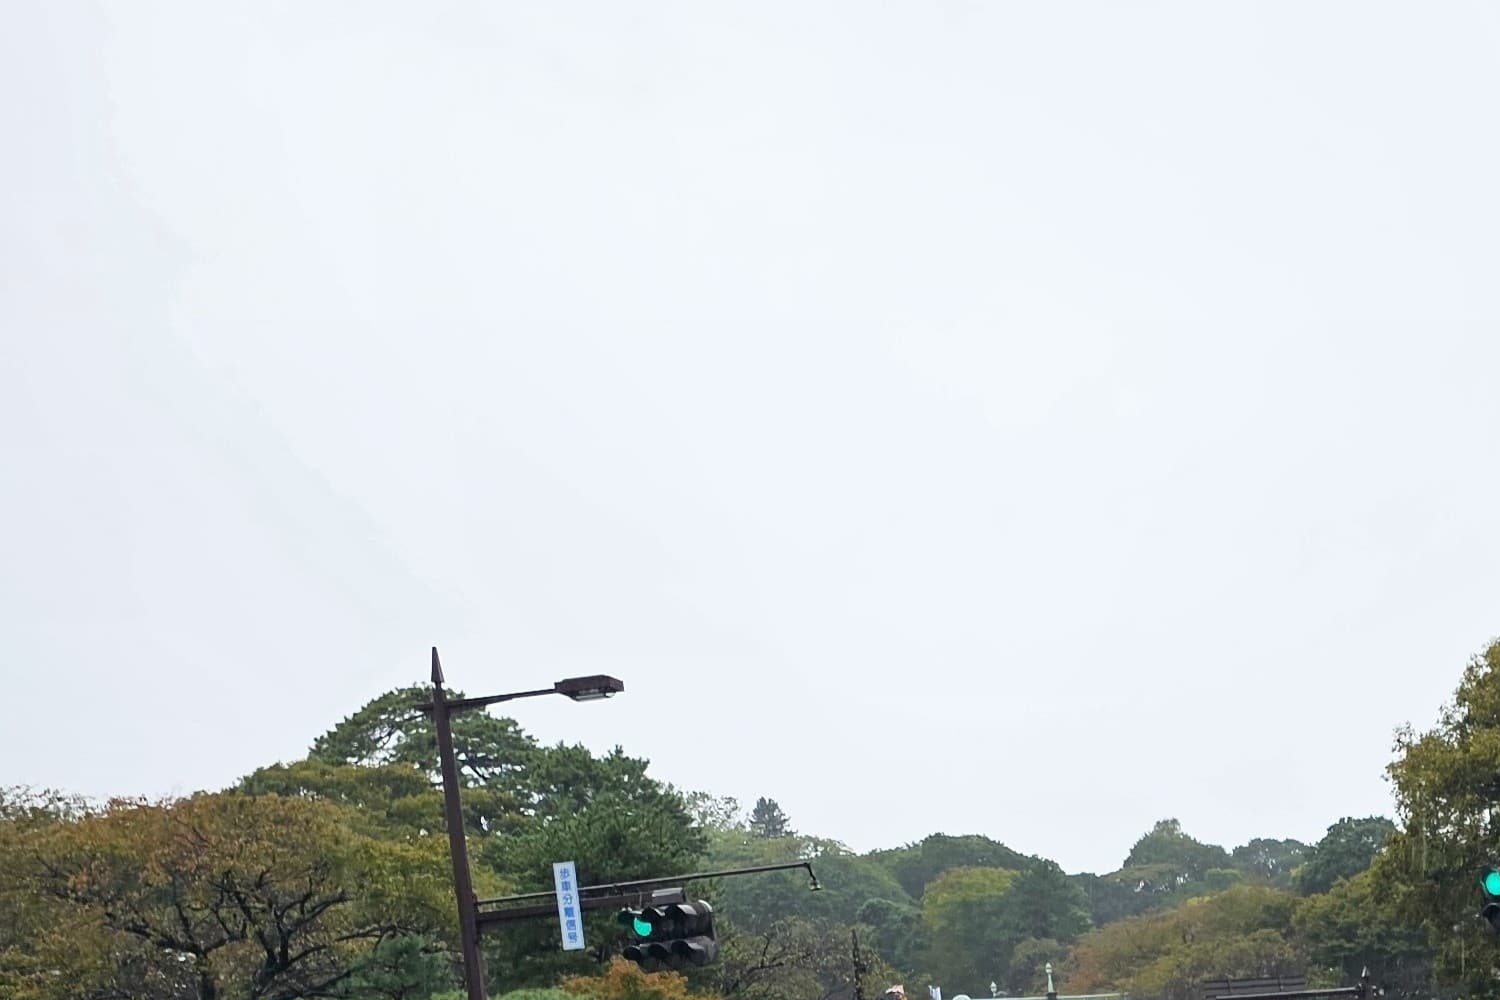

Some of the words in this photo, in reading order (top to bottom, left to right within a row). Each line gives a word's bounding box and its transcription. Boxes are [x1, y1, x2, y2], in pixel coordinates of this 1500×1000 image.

[559, 868, 578, 943] 歩車分離信号
